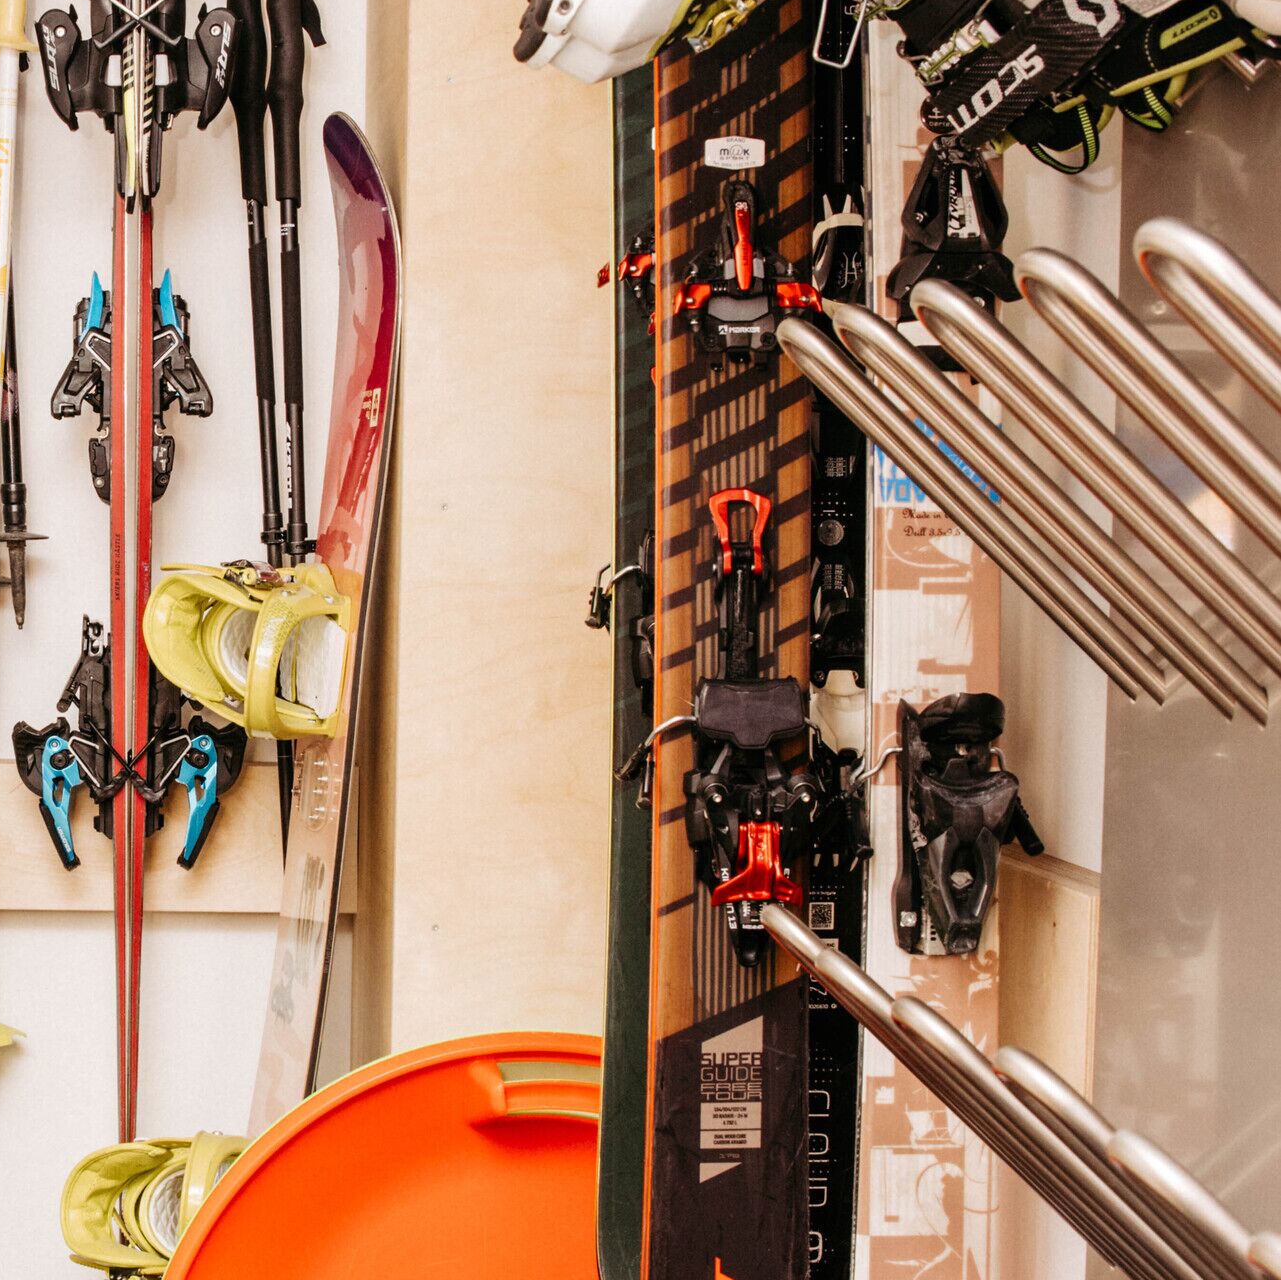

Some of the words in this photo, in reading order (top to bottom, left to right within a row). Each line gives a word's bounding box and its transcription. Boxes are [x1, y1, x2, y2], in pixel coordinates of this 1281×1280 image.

[946, 44, 1046, 134] SCOTT
[701, 1052, 762, 1066] SUPER
[701, 1066, 763, 1082] GUIDE
[701, 1082, 762, 1092] FREE
[701, 1092, 762, 1101] TOUR
